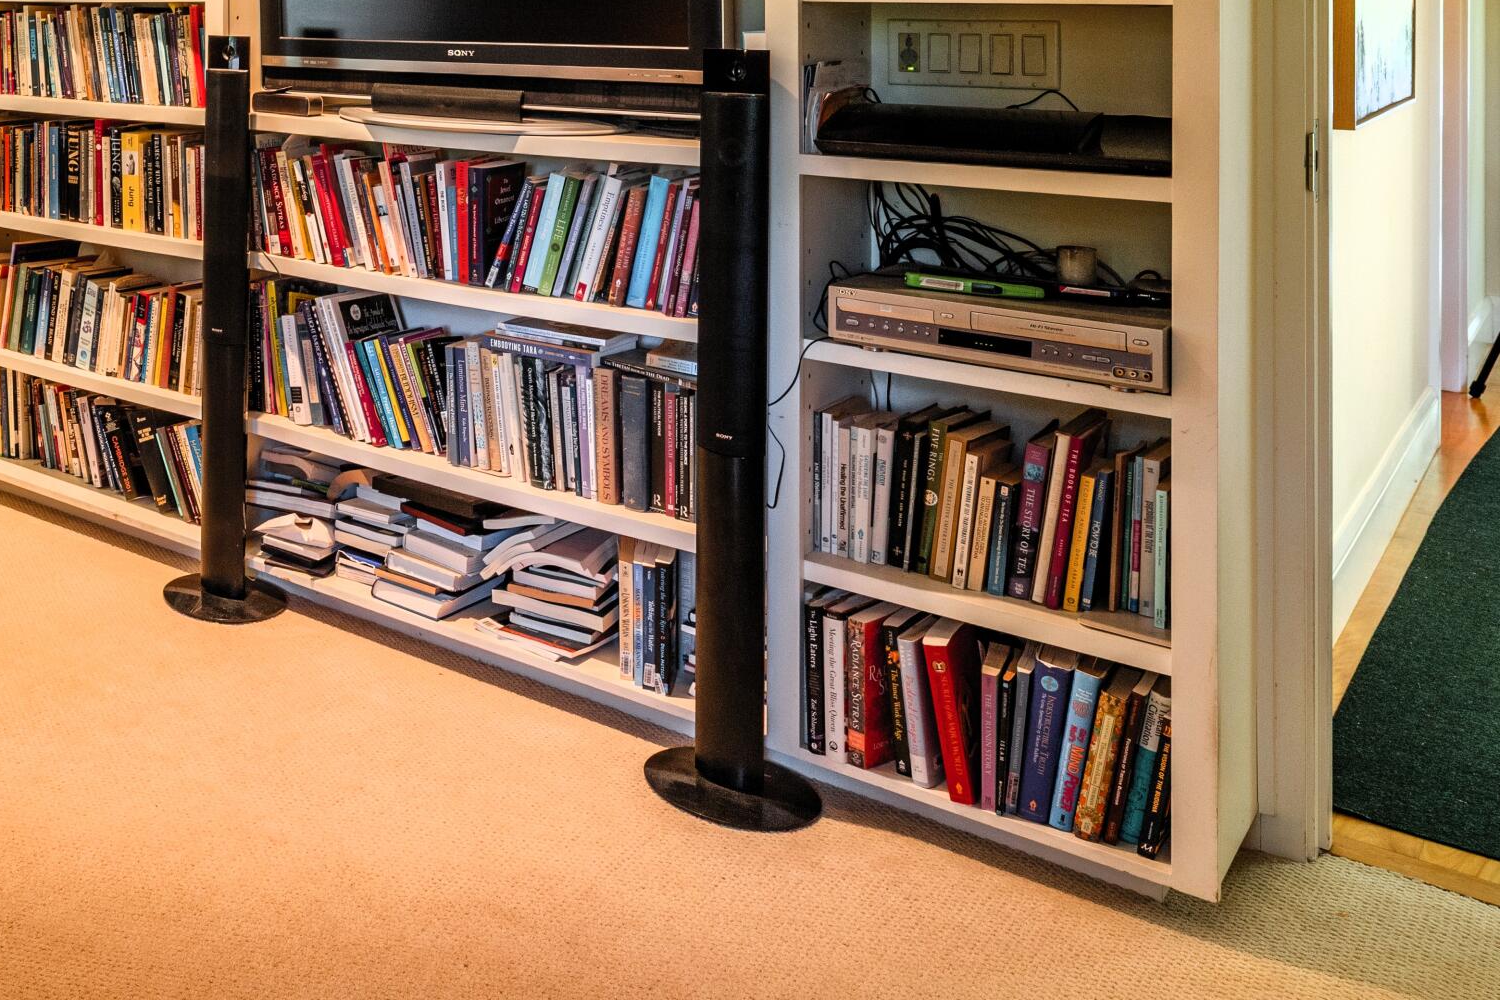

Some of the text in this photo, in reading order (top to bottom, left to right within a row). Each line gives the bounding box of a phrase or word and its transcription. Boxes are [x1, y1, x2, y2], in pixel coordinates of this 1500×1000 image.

[447, 49, 475, 57] SONY
[68, 131, 79, 172] JUNG
[269, 163, 285, 229] RADIANCE SUTRAS
[597, 192, 615, 231] Emptiness
[307, 317, 318, 335] LIGHT
[490, 338, 537, 355] EMBODYING TARA
[601, 375, 611, 500] DREAMS AND SYMBOLS
[112, 435, 127, 476] CAMBRIDGE
[927, 428, 941, 481] FIVE RINGS
[1070, 450, 1079, 465] THE
[839, 463, 847, 485] Healing
[1066, 468, 1076, 490] BOOK
[1062, 508, 1072, 522] TEA
[1016, 488, 1036, 574] THE STORY OF TEA
[1092, 520, 1100, 539] HOW
[808, 620, 820, 641] Light
[828, 627, 837, 655] Meeting
[810, 643, 819, 668] Eaters
[829, 670, 837, 689] Great
[851, 639, 862, 729] RADIANCE SUTRAS
[829, 691, 837, 707] Bliss
[891, 682, 900, 700] Inner
[984, 694, 993, 708] THE
[893, 701, 901, 718] Work
[828, 709, 838, 732] Queen
[1141, 704, 1159, 746] Civilization
[1163, 743, 1171, 753] THE
[1159, 754, 1169, 771] VISION
